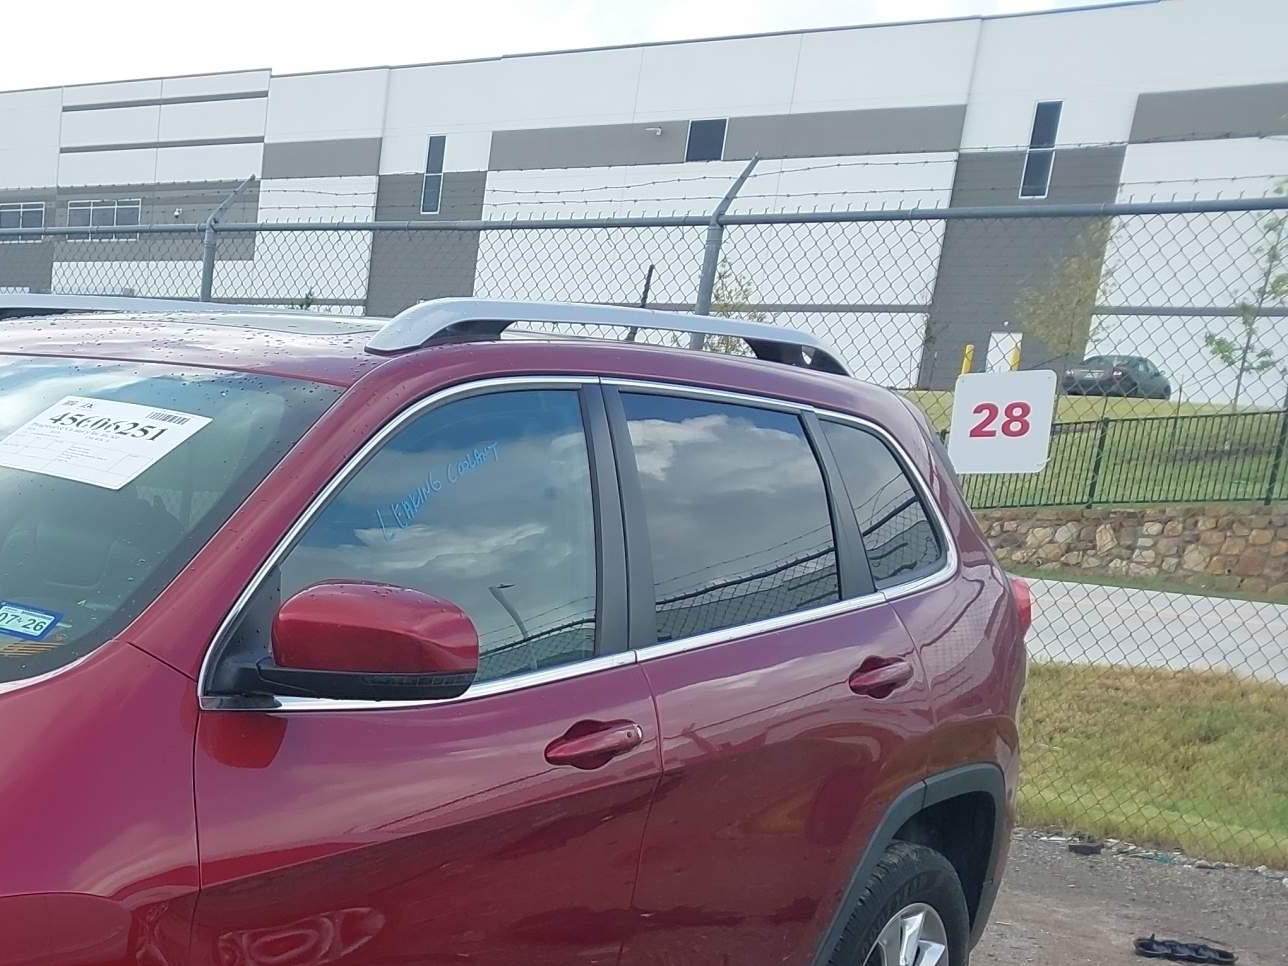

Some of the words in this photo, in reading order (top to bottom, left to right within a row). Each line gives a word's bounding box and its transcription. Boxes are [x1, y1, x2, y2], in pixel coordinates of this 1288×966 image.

[48, 411, 169, 441] 45606251
[969, 401, 1032, 438] 28
[376, 471, 442, 544] LEAKING
[21, 617, 47, 632] 26
